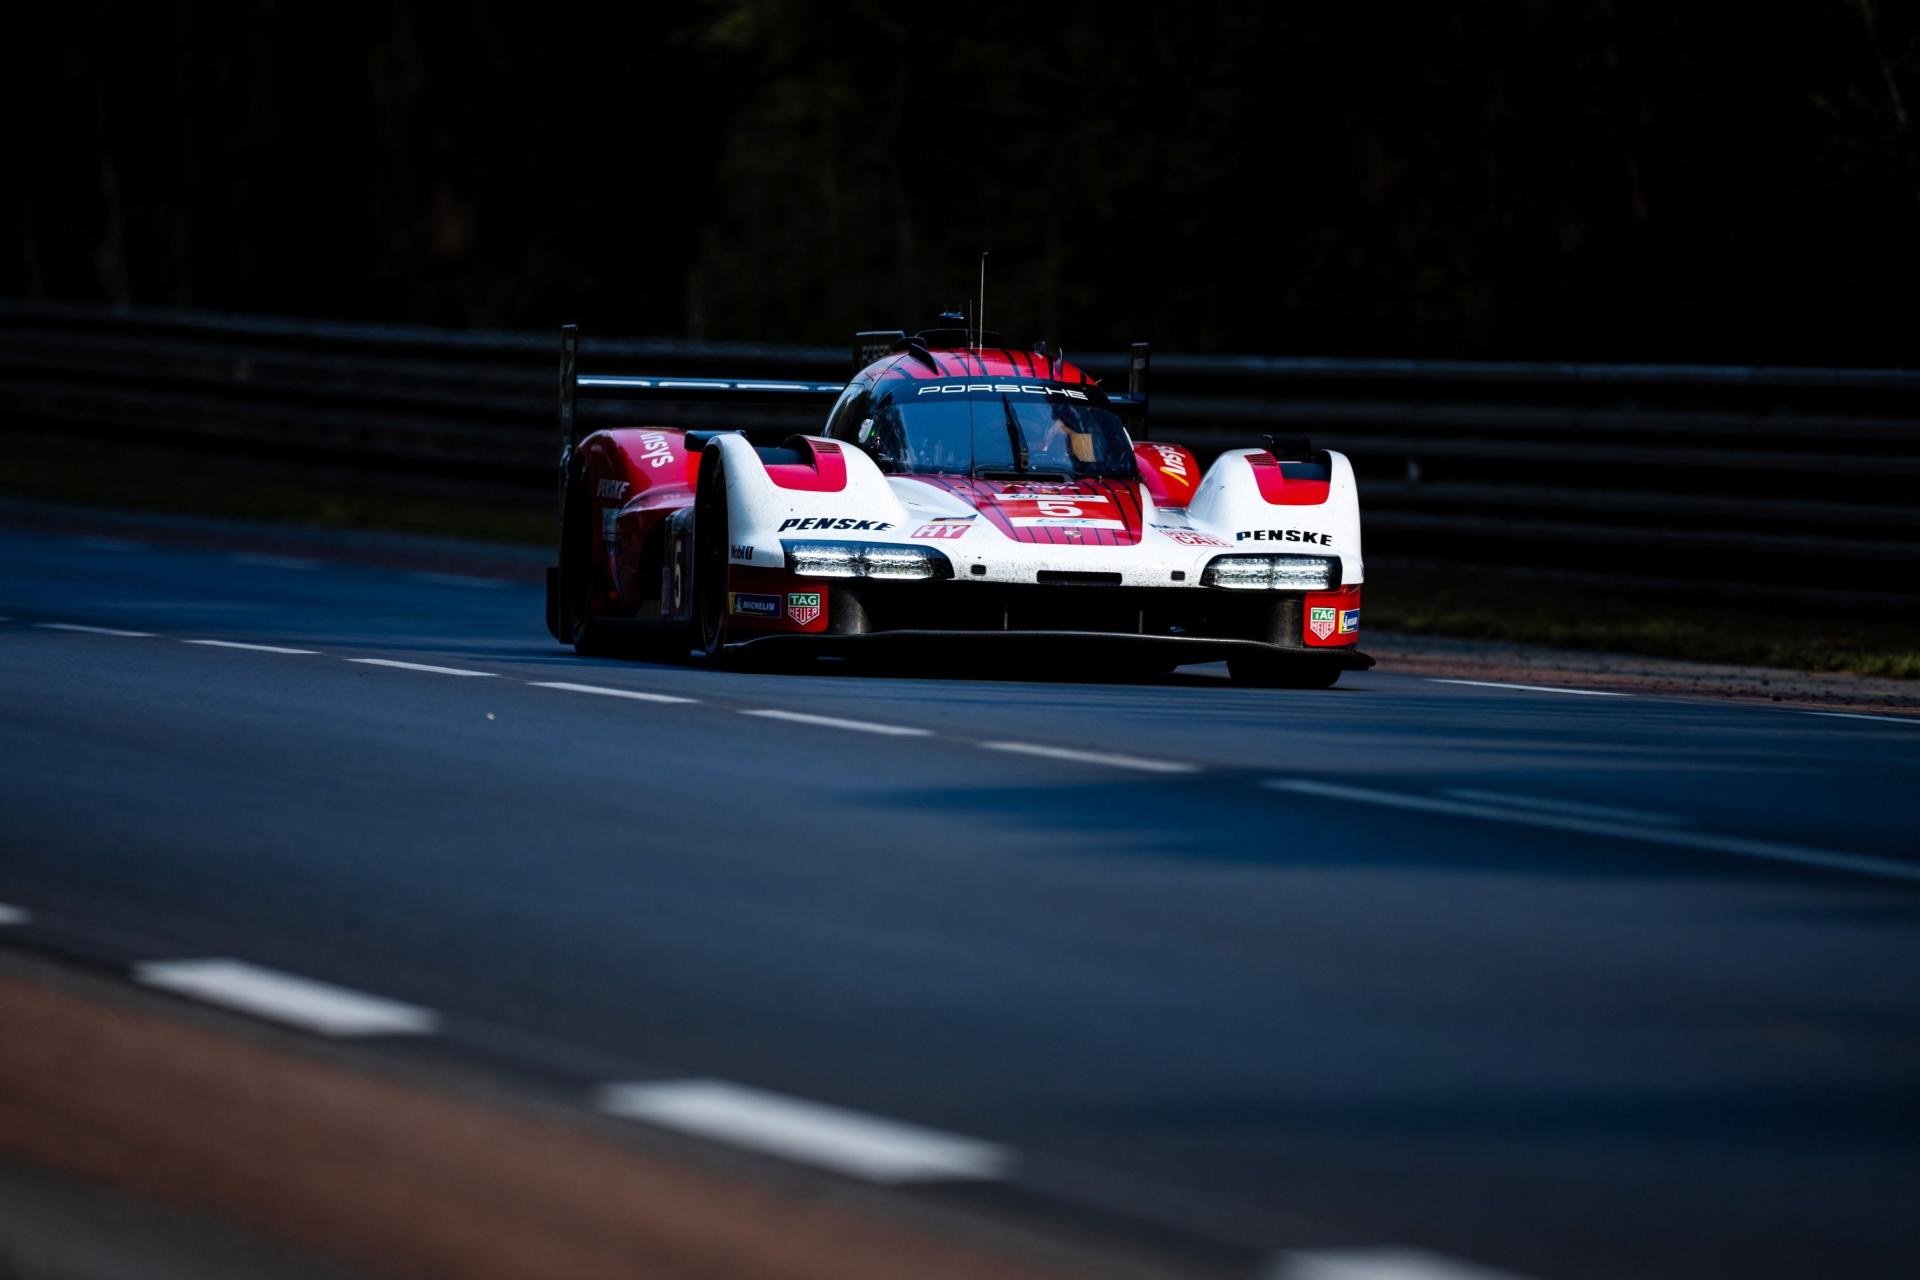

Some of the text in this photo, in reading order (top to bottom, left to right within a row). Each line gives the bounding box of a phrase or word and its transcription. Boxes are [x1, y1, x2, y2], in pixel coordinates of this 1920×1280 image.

[917, 384, 1088, 401] PORSCHE
[1037, 500, 1083, 517] 5
[777, 518, 896, 532] PENSKE
[1236, 530, 1332, 546] PENSKE
[743, 602, 775, 611] MICHELIN
[791, 596, 817, 605] TAG
[789, 608, 818, 622] HEUER
[1312, 610, 1335, 620] TAG
